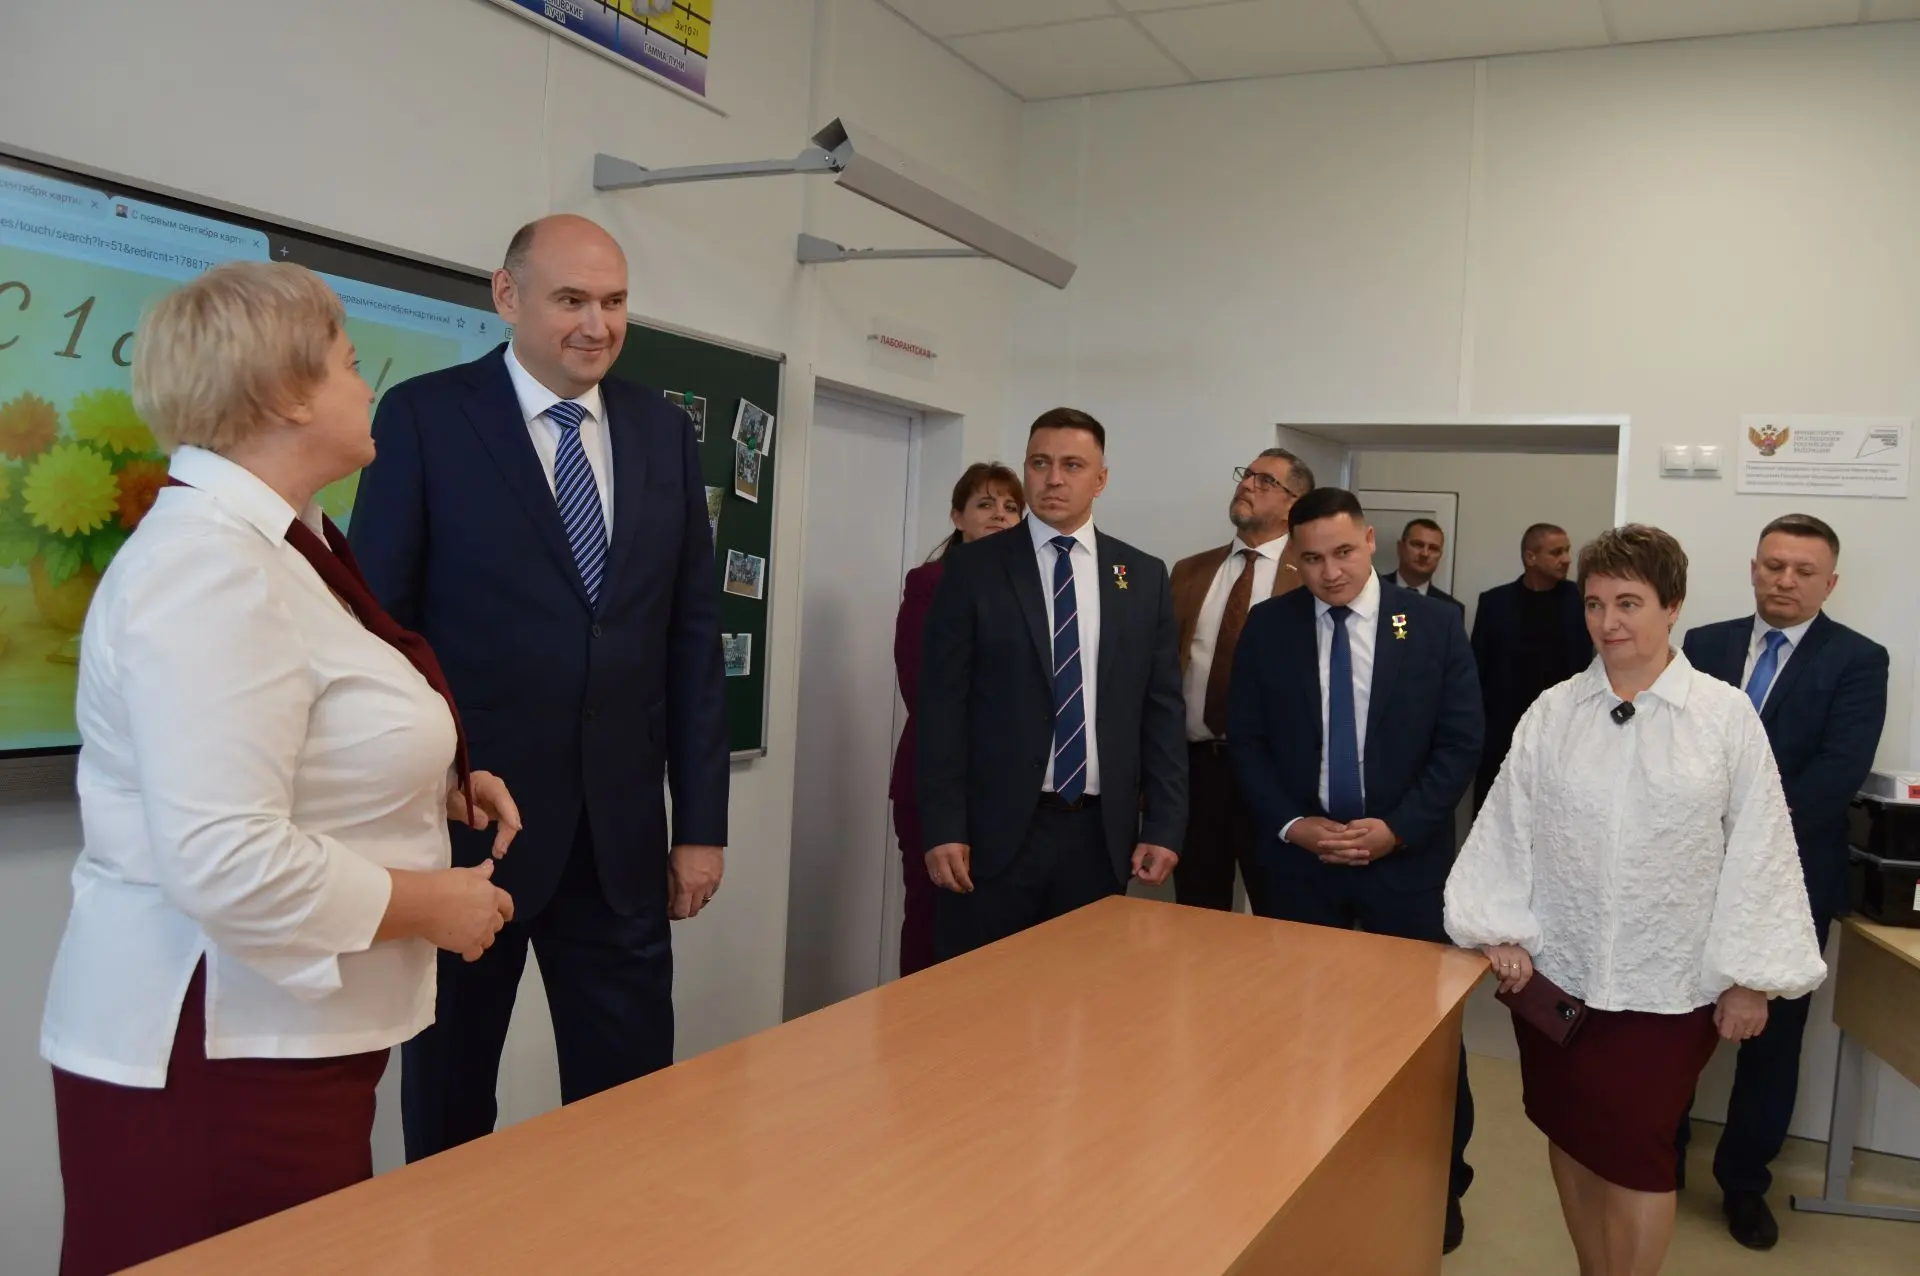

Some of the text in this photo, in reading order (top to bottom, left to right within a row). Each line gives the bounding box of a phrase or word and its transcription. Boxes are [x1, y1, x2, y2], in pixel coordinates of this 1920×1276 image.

[546, 5, 565, 23] ЛУЧИ
[644, 42, 685, 71] ГАММА ЛУЧИ
[131, 209, 138, 220] С
[140, 213, 177, 228] первым
[178, 222, 219, 239] сентября
[54, 296, 96, 359] 1
[880, 335, 931, 359] ЛАБОРАНТСКАЯ
